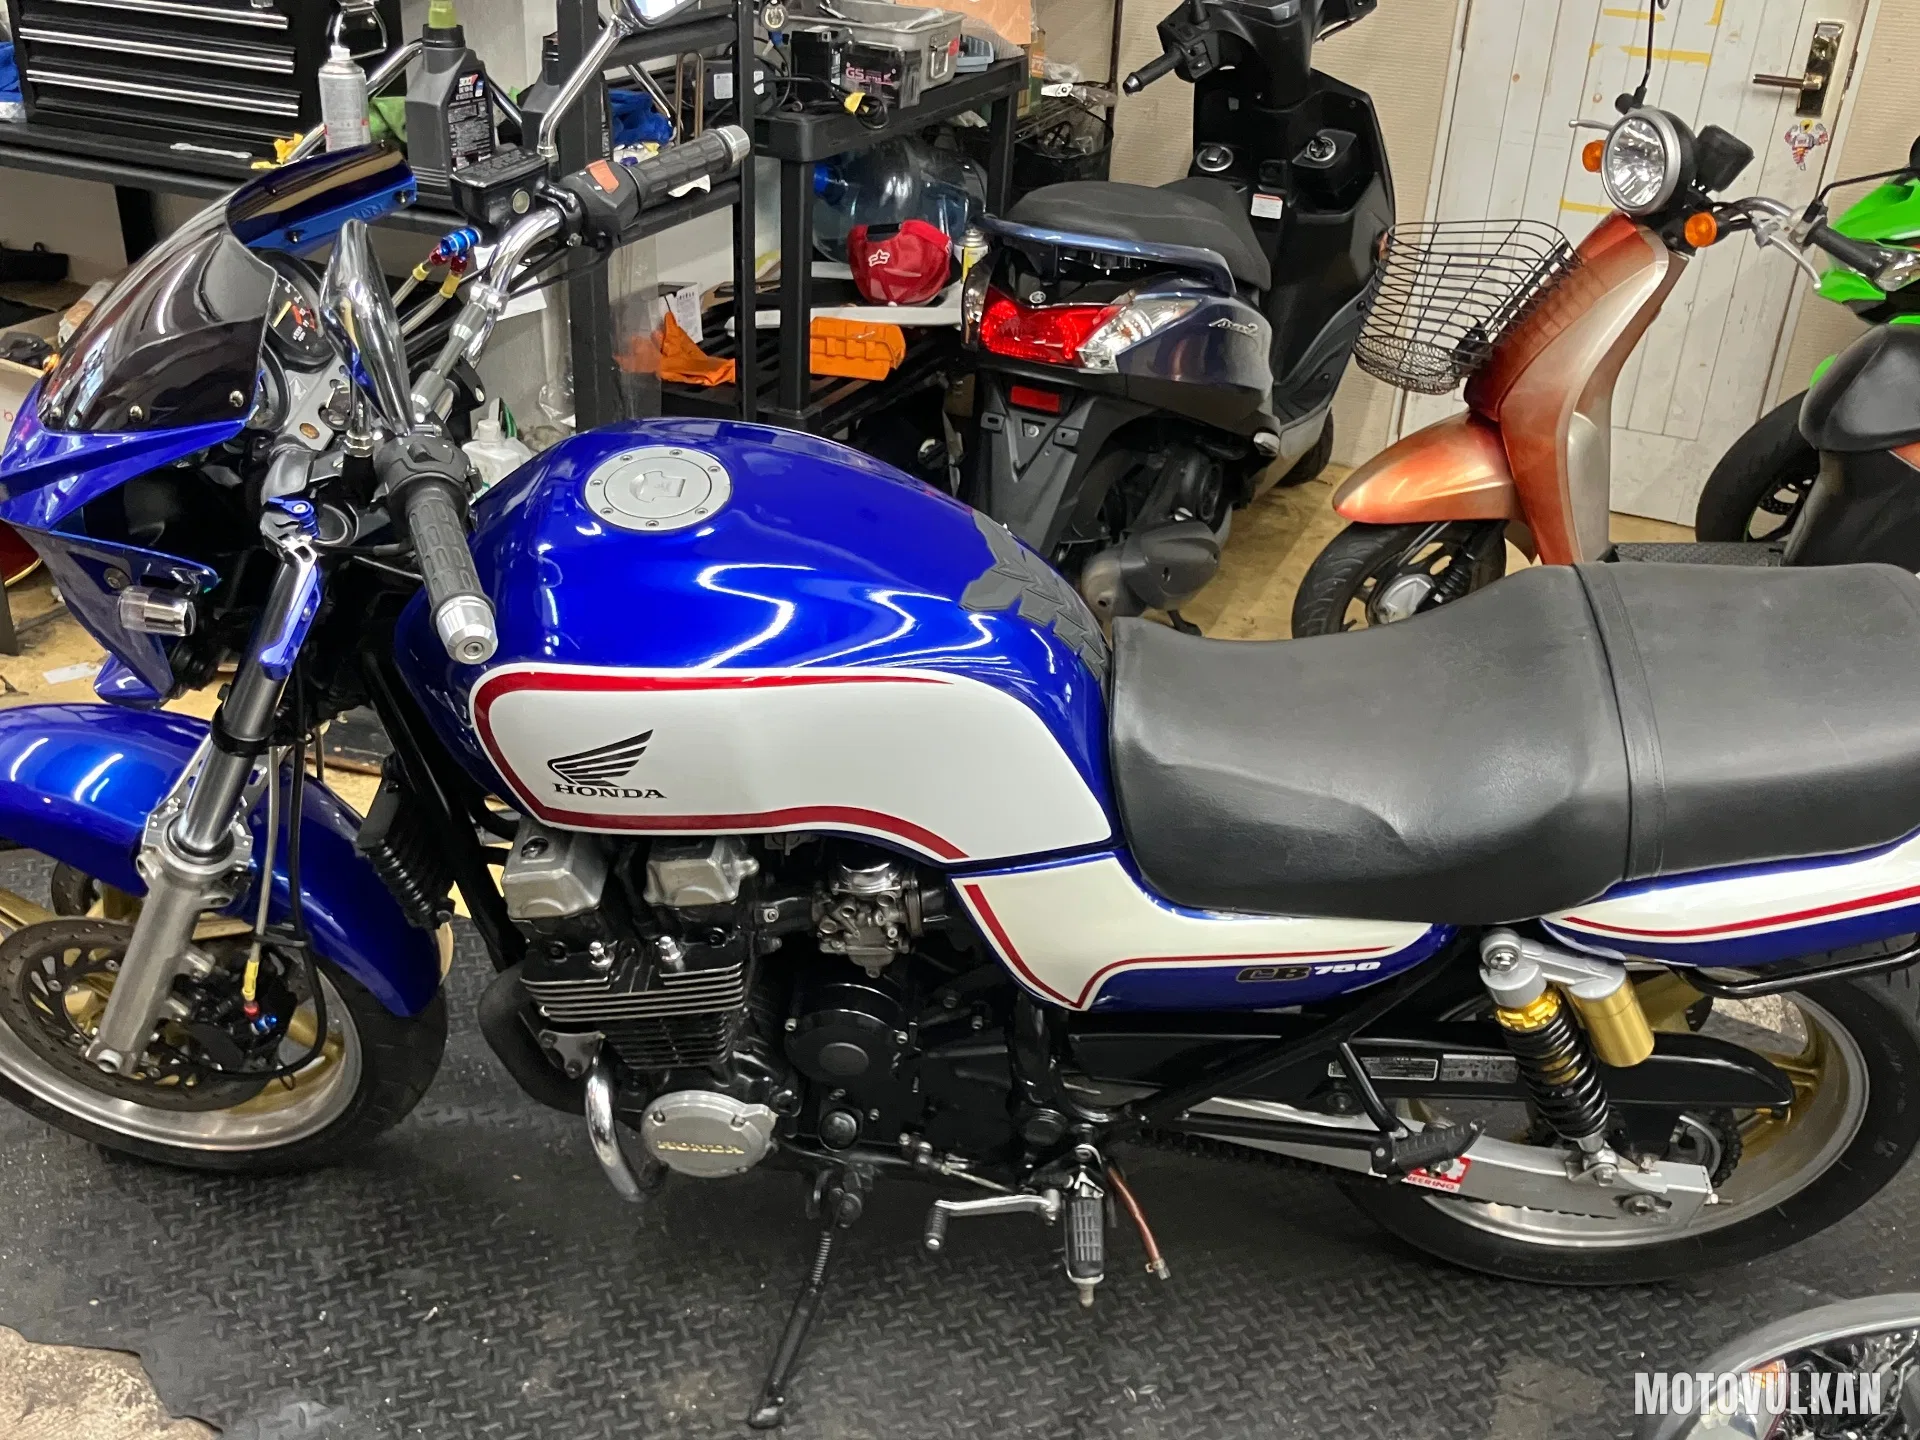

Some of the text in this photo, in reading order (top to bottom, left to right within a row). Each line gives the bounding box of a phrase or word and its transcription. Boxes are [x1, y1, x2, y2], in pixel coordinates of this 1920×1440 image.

[552, 782, 668, 799] HONDA
[1236, 961, 1381, 982] CB 750
[657, 1140, 745, 1155] HONDA
[1407, 1173, 1455, 1190] NEERING
